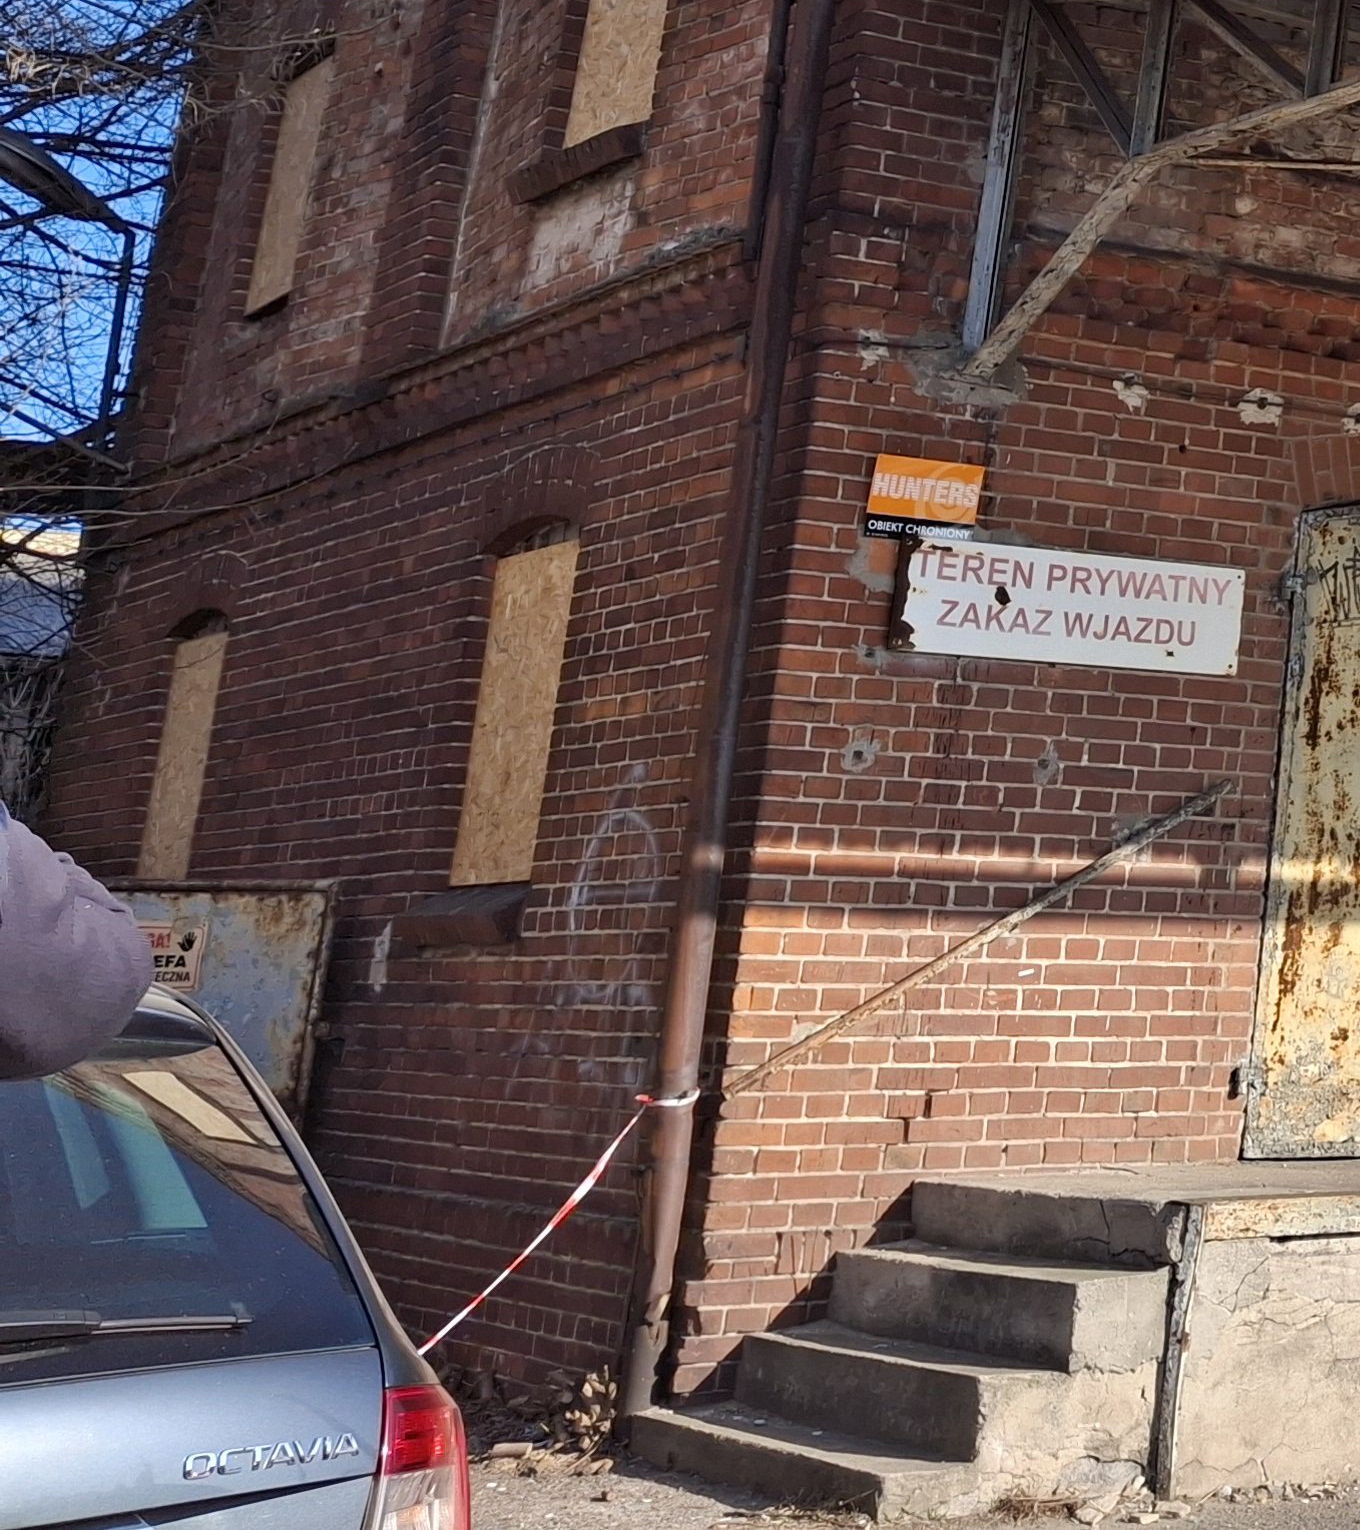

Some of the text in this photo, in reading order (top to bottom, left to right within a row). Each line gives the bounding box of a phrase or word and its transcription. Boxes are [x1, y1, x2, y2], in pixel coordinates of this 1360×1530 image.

[871, 472, 979, 508] HUNTERS
[867, 519, 970, 540] OBIEKT CHRONIONY
[916, 548, 1232, 606] TEREN PRYWATNY
[936, 599, 1196, 646] ZAKAZ WJAZDU
[183, 1433, 359, 1480] OCTAVIA
